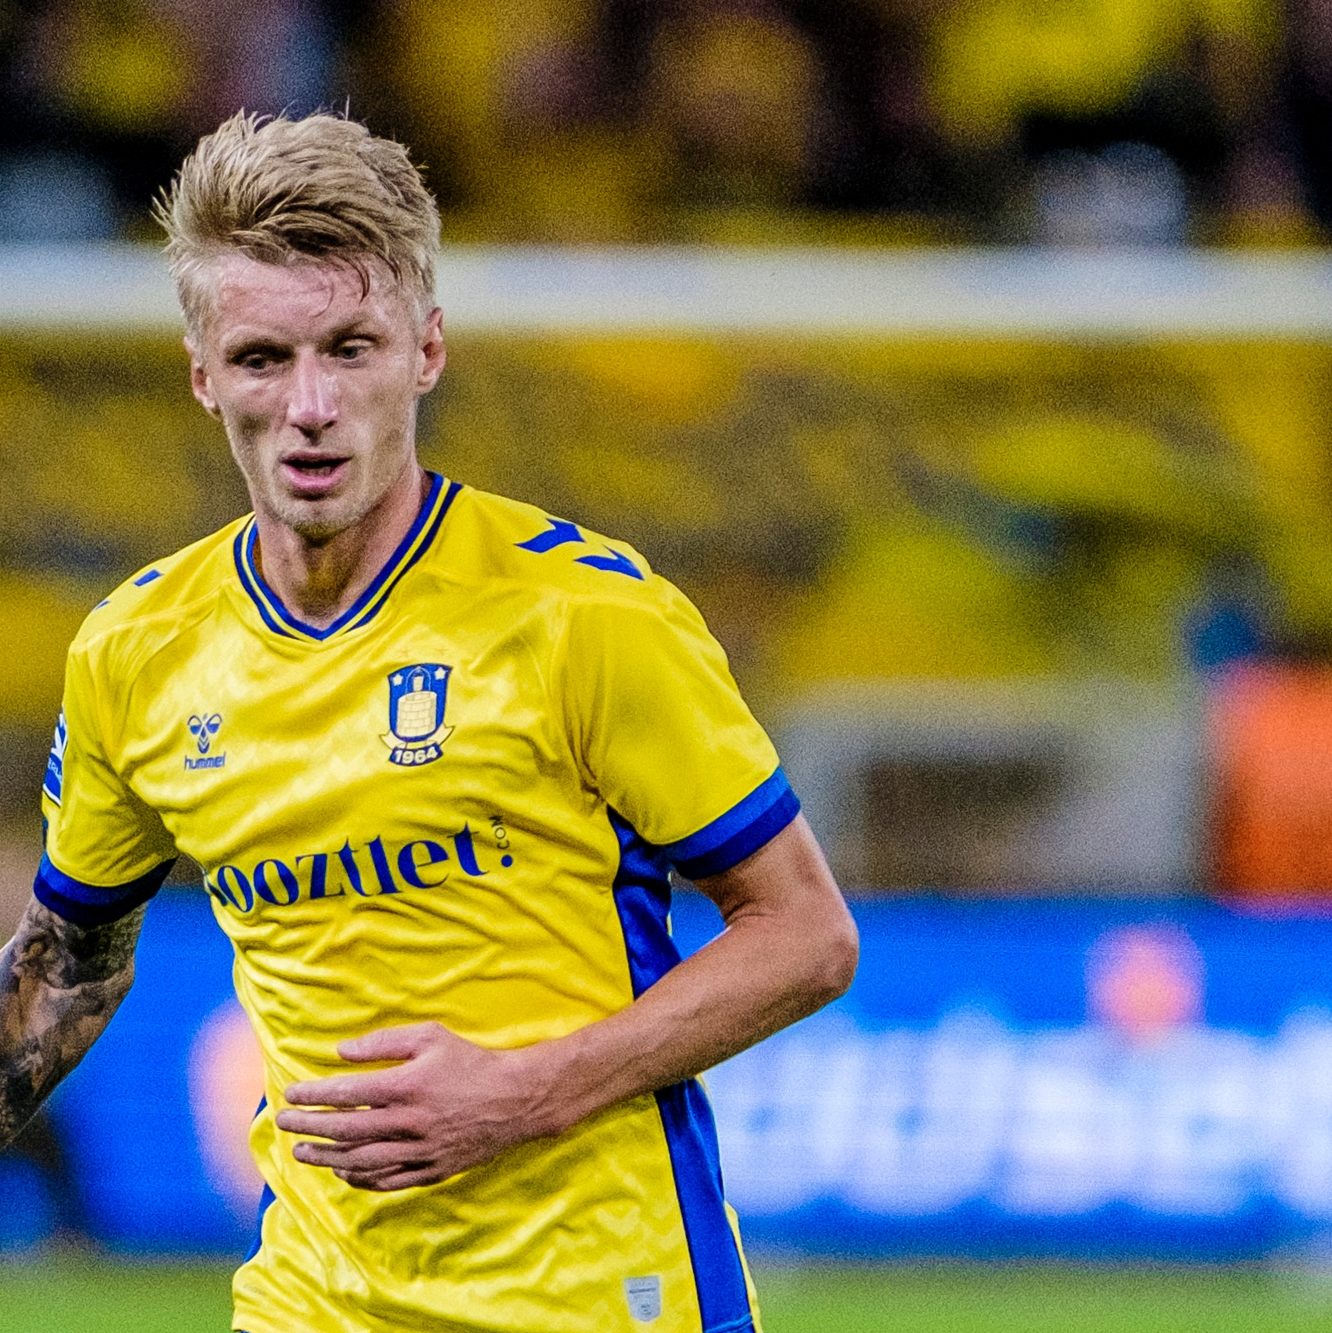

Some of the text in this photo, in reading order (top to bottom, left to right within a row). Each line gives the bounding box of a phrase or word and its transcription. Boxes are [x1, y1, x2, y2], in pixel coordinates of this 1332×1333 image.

[184, 751, 227, 771] hummel
[394, 745, 438, 765] 1964
[208, 820, 514, 914] ooztlet.
